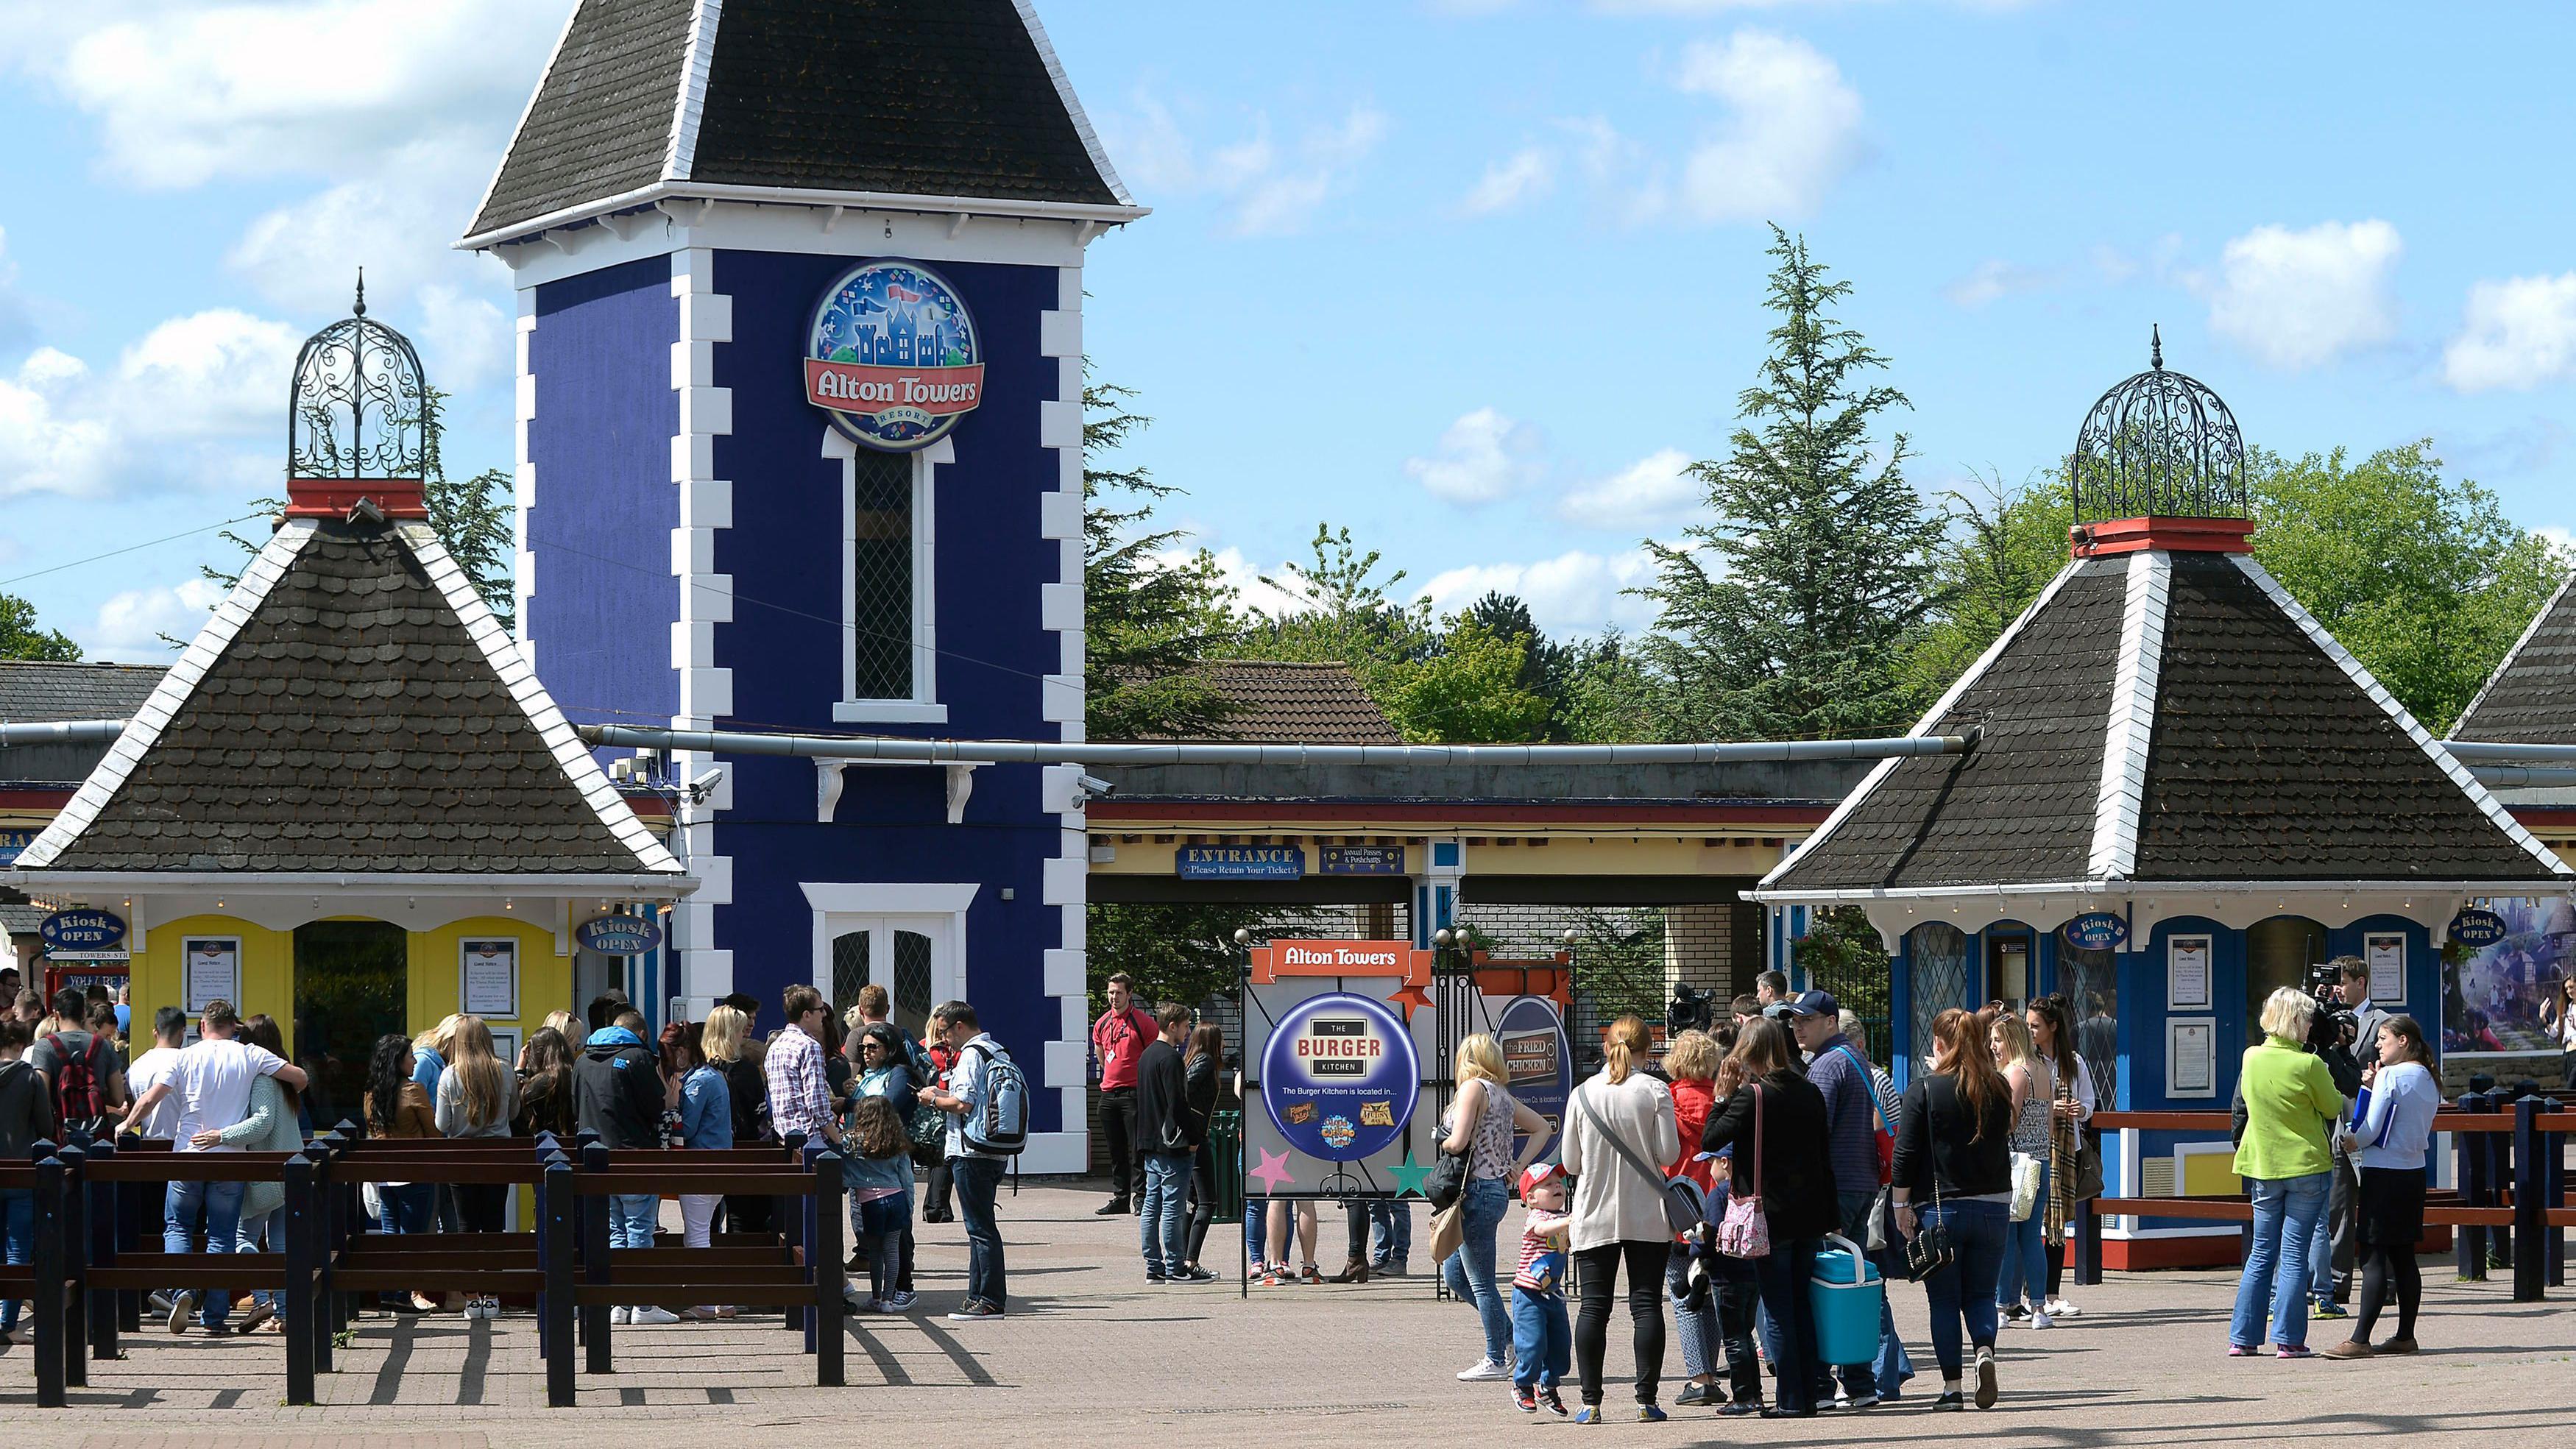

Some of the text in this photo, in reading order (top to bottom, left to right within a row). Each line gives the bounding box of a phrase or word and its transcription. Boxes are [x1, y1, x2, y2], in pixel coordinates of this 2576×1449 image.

[817, 369, 976, 403] Alton Towers
[880, 410, 929, 423] RESORT
[1189, 849, 1294, 863] ENTRANCE
[1351, 856, 1381, 864] Pushchairs
[1191, 865, 1291, 874] Please Retain Your Ticket
[60, 915, 107, 929] Kiosk
[2081, 919, 2115, 932] Kiosk
[2462, 915, 2494, 928] Kiosk
[587, 919, 652, 938] Kiosk
[2463, 929, 2491, 939] OPEN
[62, 931, 103, 941] OPEN
[2084, 932, 2111, 942] OPEN
[595, 939, 640, 951] OPEN
[1284, 946, 1396, 966] Alton Towers
[1298, 1039, 1380, 1057] BURGER
[1506, 1040, 1546, 1054] the FRIED
[1507, 1059, 1546, 1072] CHICKEN
[1283, 1087, 1397, 1097] The Burger Kitchen is located in...
